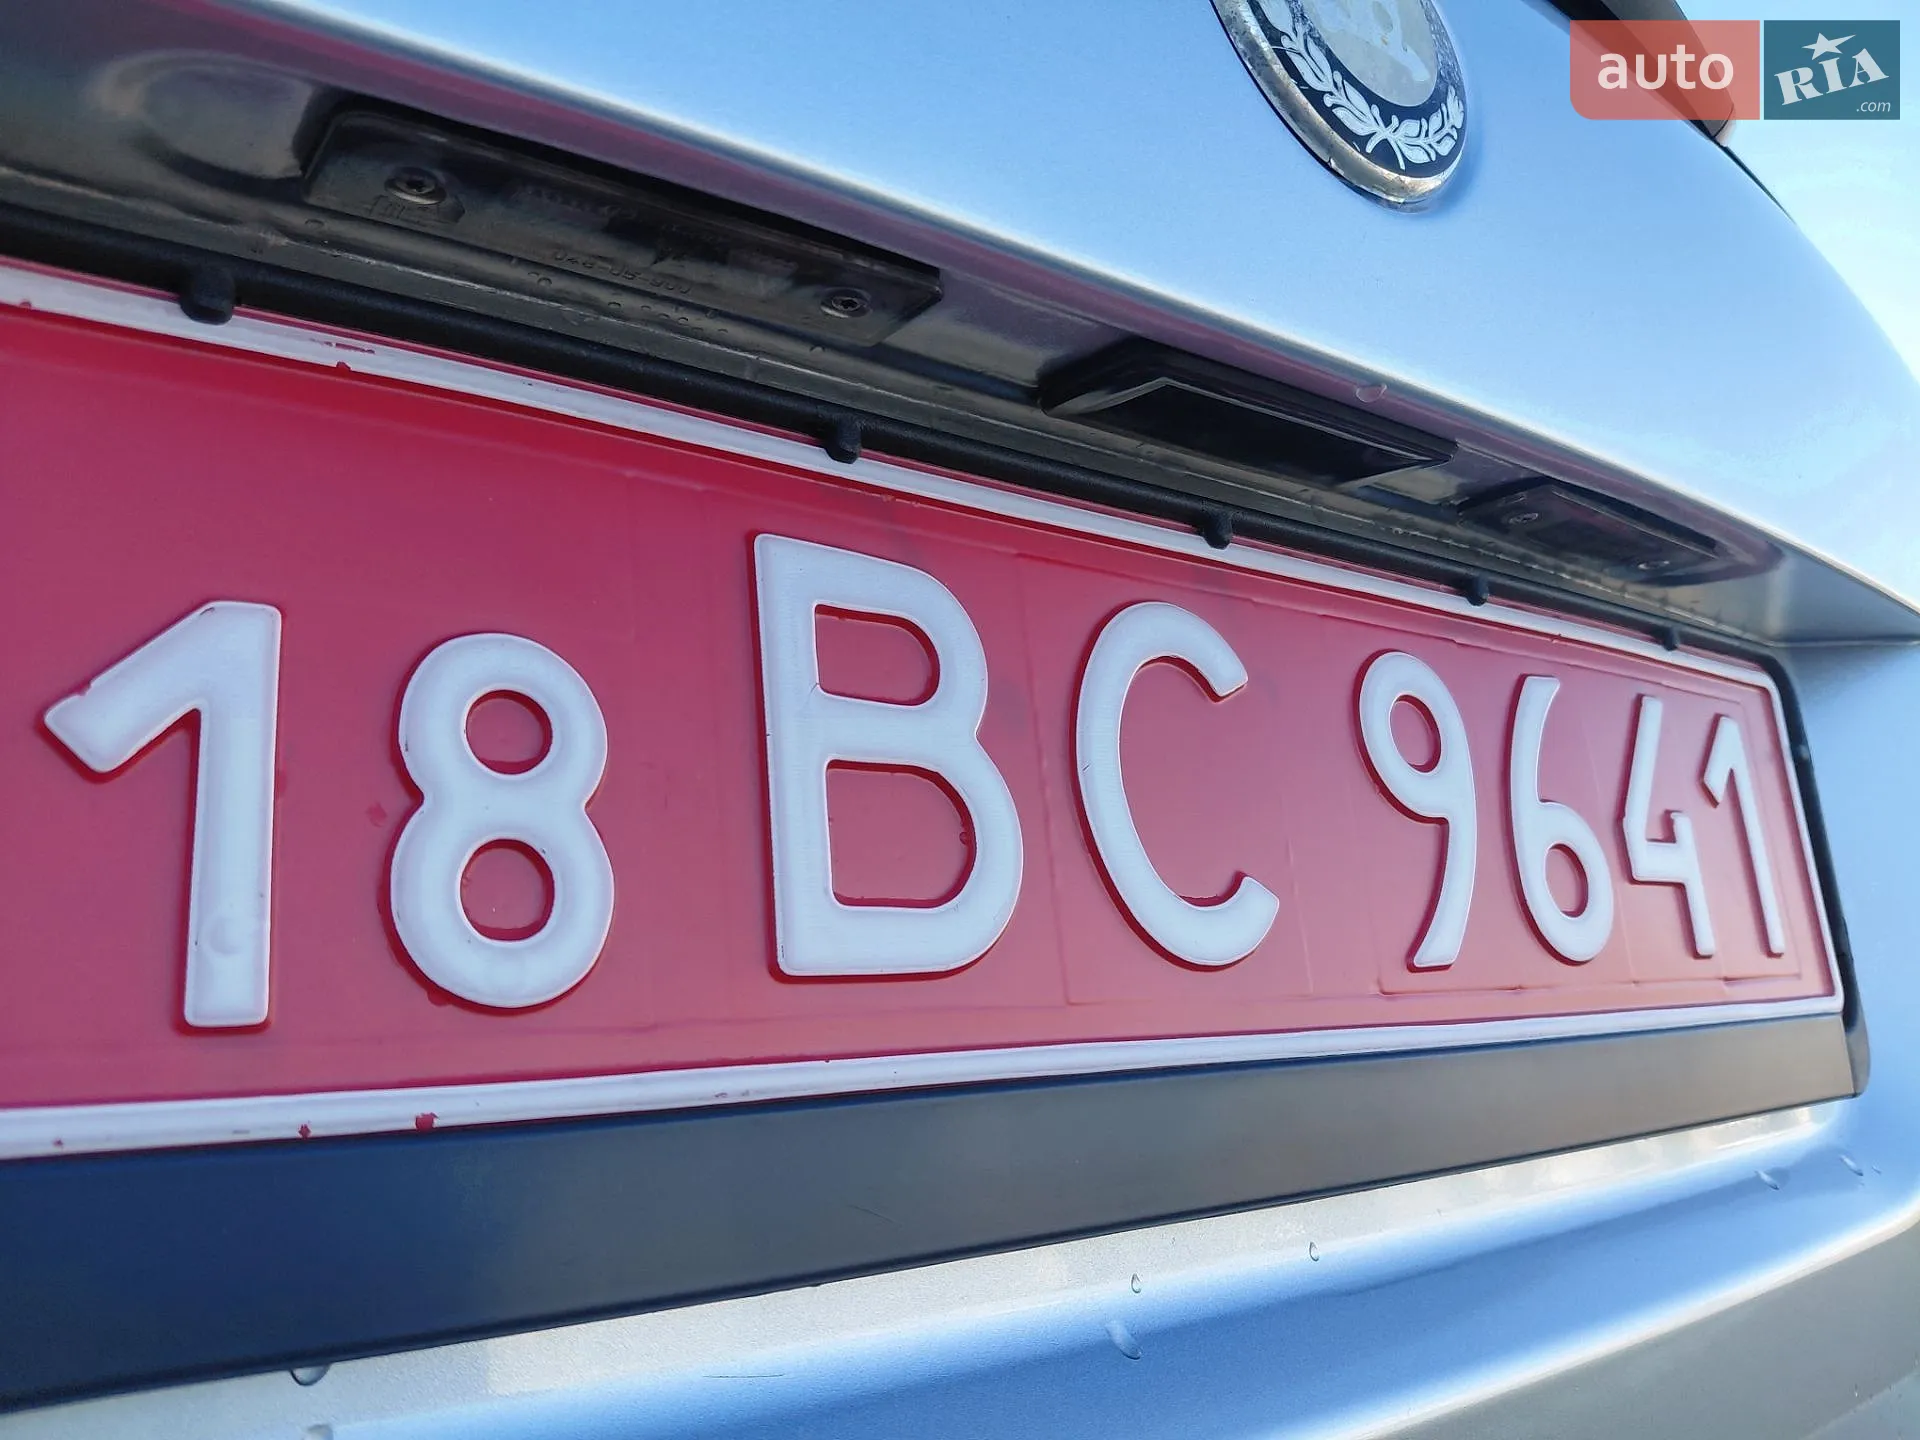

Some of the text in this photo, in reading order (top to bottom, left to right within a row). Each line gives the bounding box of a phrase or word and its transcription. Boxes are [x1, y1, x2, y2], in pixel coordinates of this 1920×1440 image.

[44, 533, 1785, 1027] 18 BC 9641
